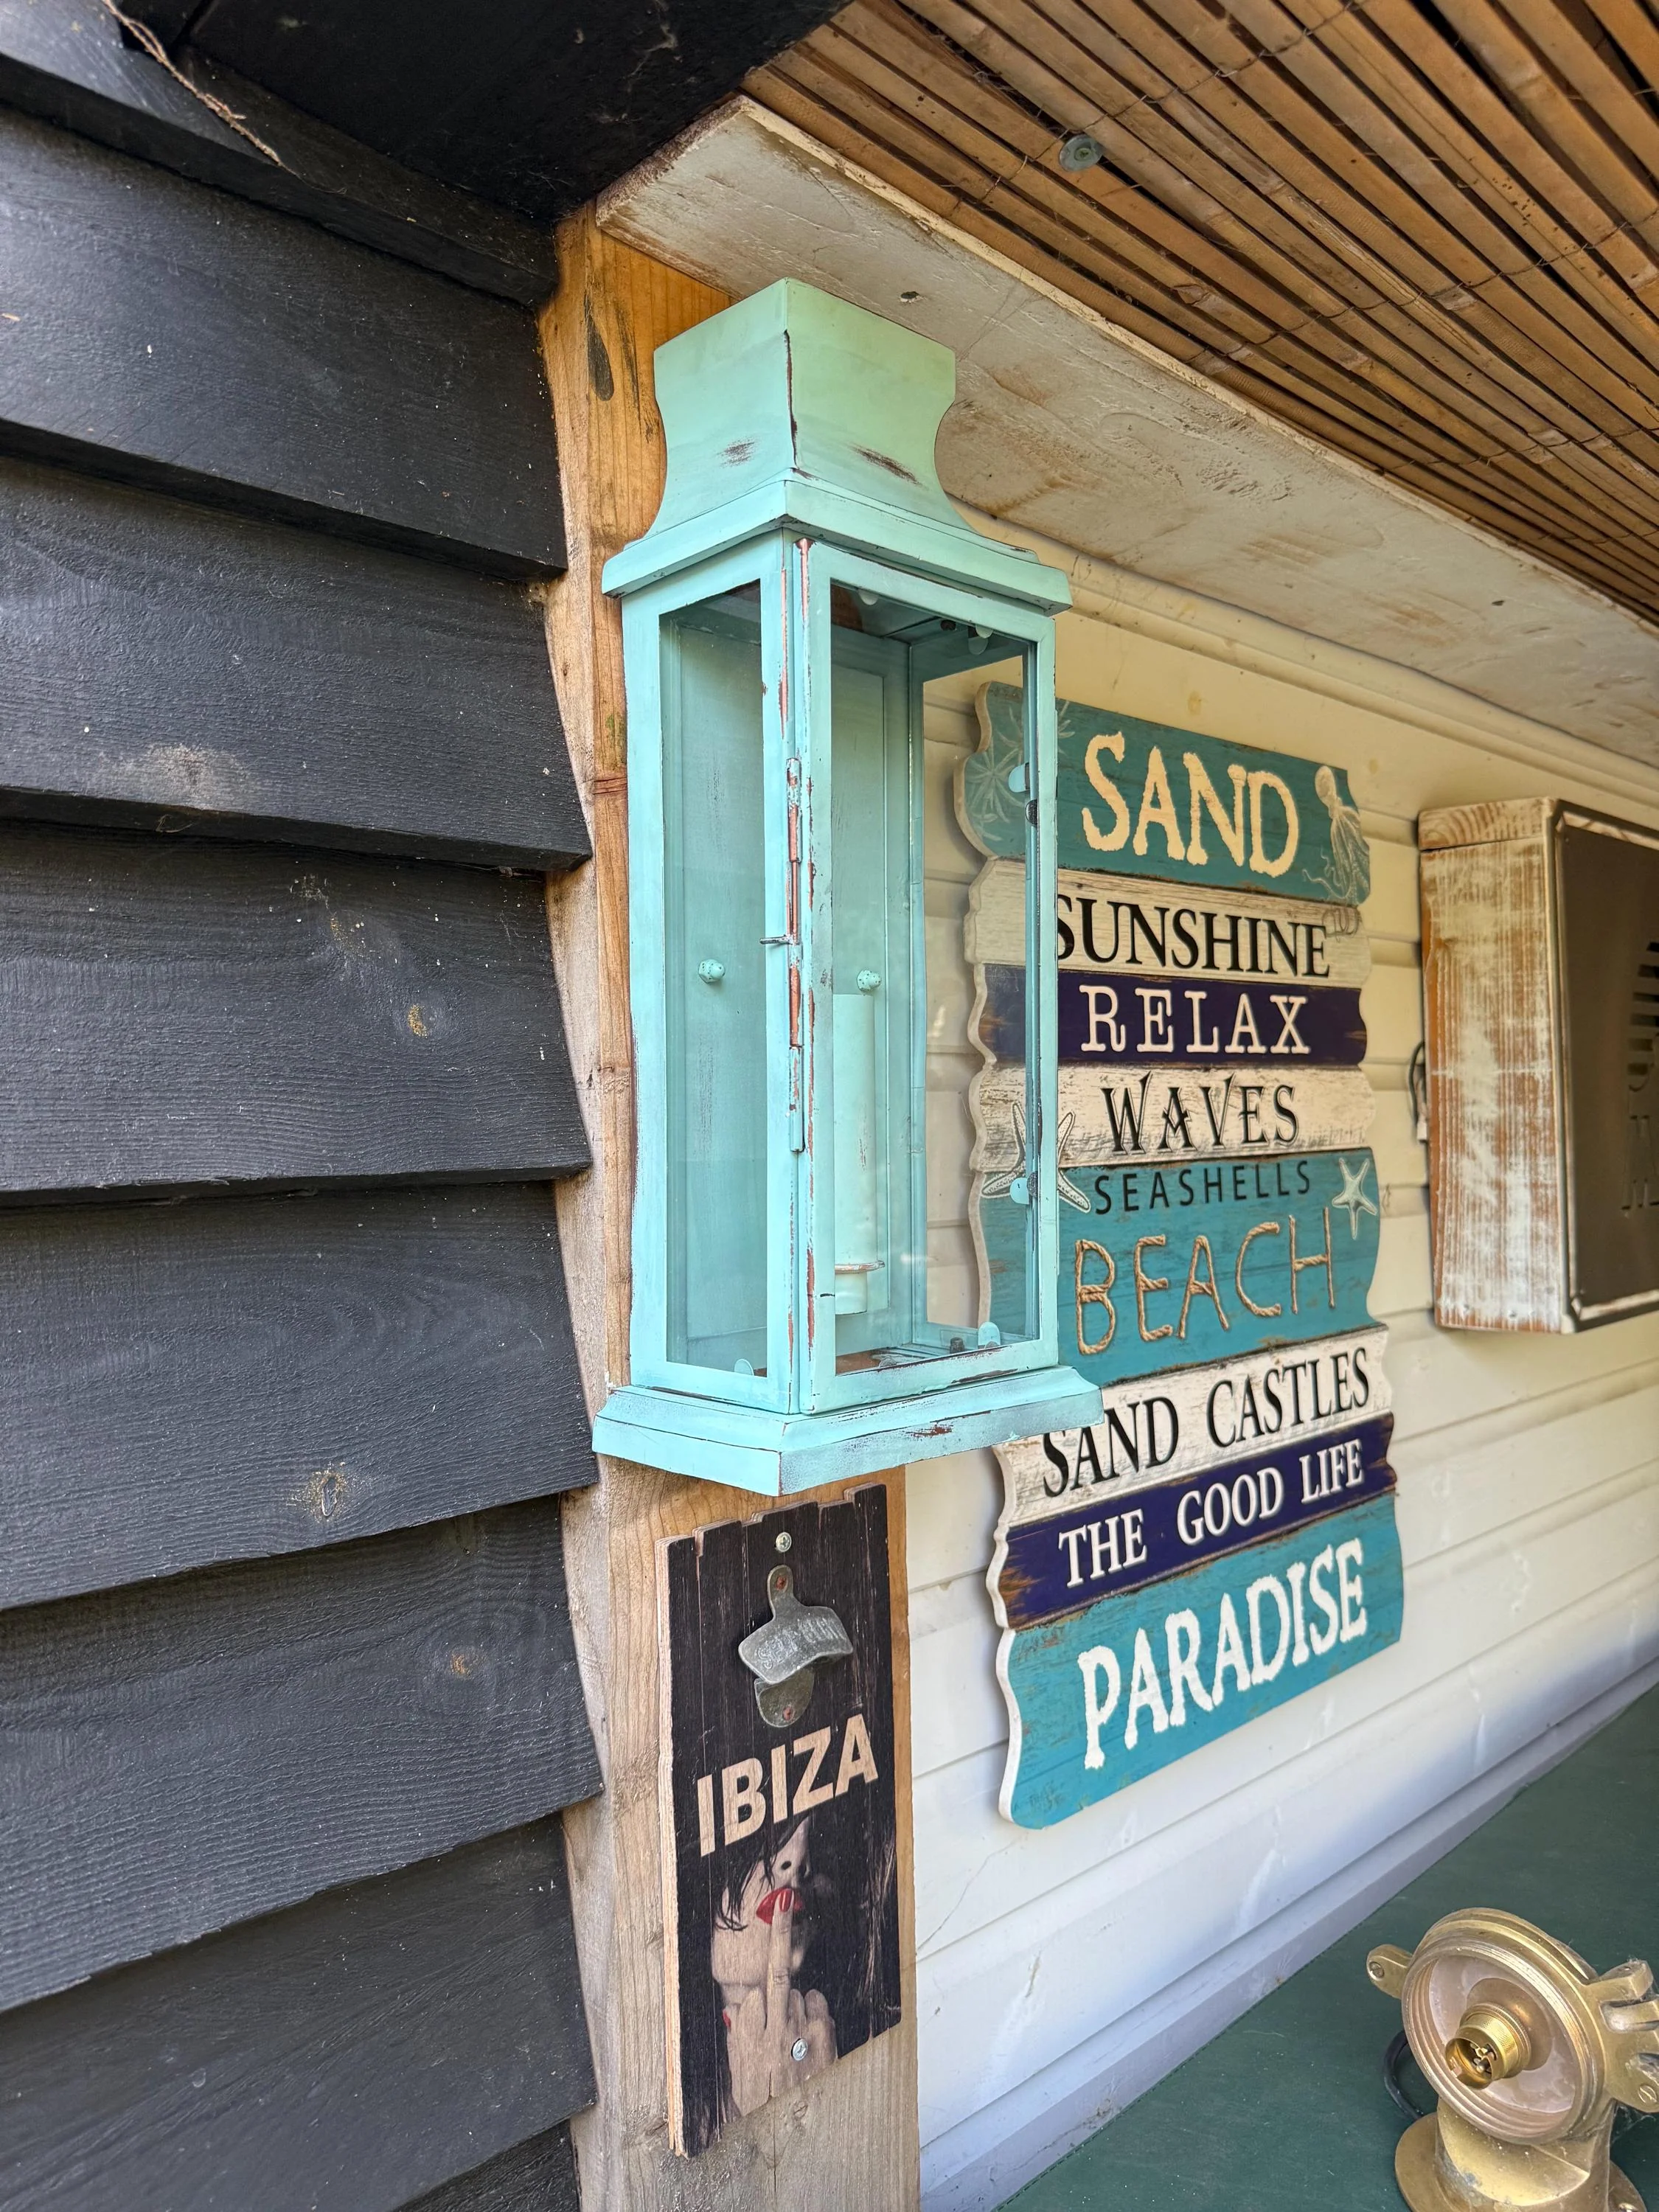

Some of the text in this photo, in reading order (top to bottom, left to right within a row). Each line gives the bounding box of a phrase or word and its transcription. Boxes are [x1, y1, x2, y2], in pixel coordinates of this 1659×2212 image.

[1081, 731, 1300, 877] SAND
[1057, 894, 1330, 979] SUNSHINE
[1079, 984, 1311, 1055] RELAX
[1100, 1071, 1301, 1156] WAVES
[1094, 1159, 1311, 1216] SEASHELLS
[1074, 1206, 1335, 1357] BEACH
[1043, 1346, 1371, 1498] SAND CASTLES
[1057, 1438, 1365, 1588] THE GOOD LIFE
[1077, 1537, 1368, 1771] PARADISE
[697, 1713, 879, 1857] IBIZA
